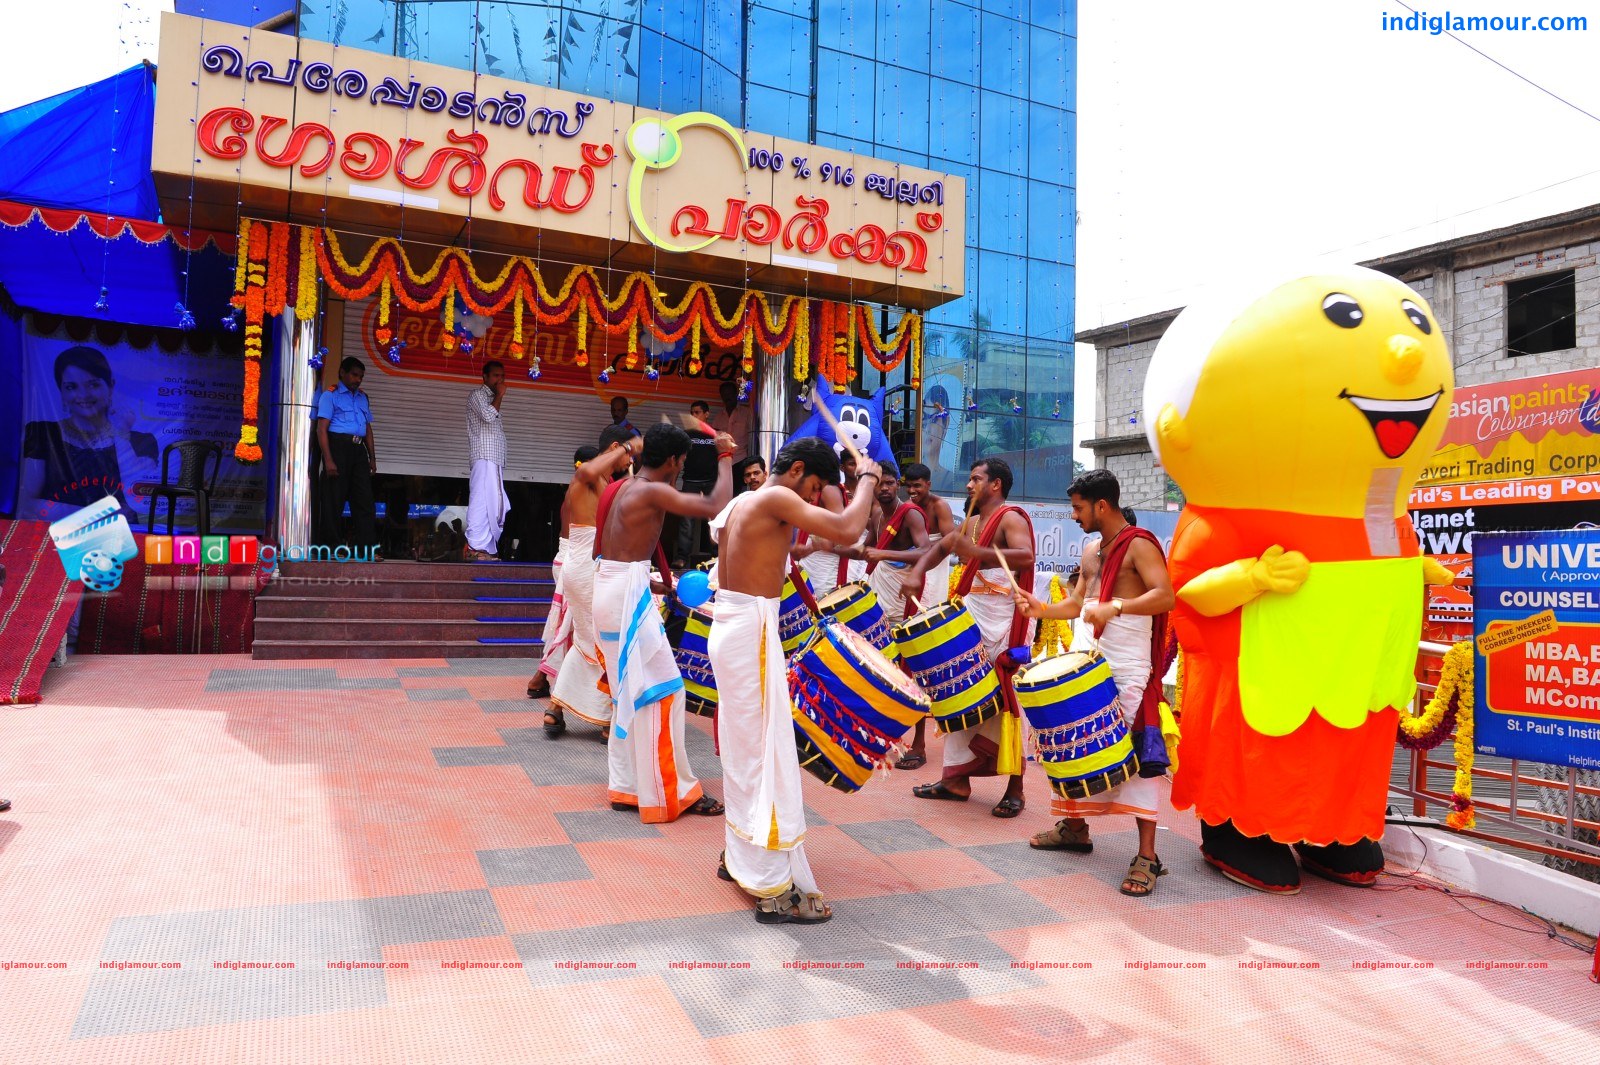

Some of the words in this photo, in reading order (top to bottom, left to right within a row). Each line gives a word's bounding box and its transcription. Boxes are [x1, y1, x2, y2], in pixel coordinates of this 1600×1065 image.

[749, 147, 784, 172] 100
[791, 156, 811, 179] %
[820, 162, 855, 187] 916
[196, 106, 614, 213] ഗോൾഡ്
[670, 194, 945, 274] പാർക്ക്
[1467, 457, 1534, 475] Trading
[1549, 454, 1600, 473] Corp
[1460, 482, 1552, 501] Leading
[1409, 508, 1475, 529] lanet
[1502, 543, 1600, 569] UNIVE
[1550, 571, 1600, 583] Approv
[1500, 590, 1600, 609] COUNSEL
[1478, 634, 1496, 645] FULL
[1497, 628, 1515, 639] TIME
[1484, 623, 1553, 651] CORRESPONDENCE
[1526, 686, 1600, 711] MCom
[1507, 719, 1523, 732] St.
[1527, 721, 1564, 736] Paul's
